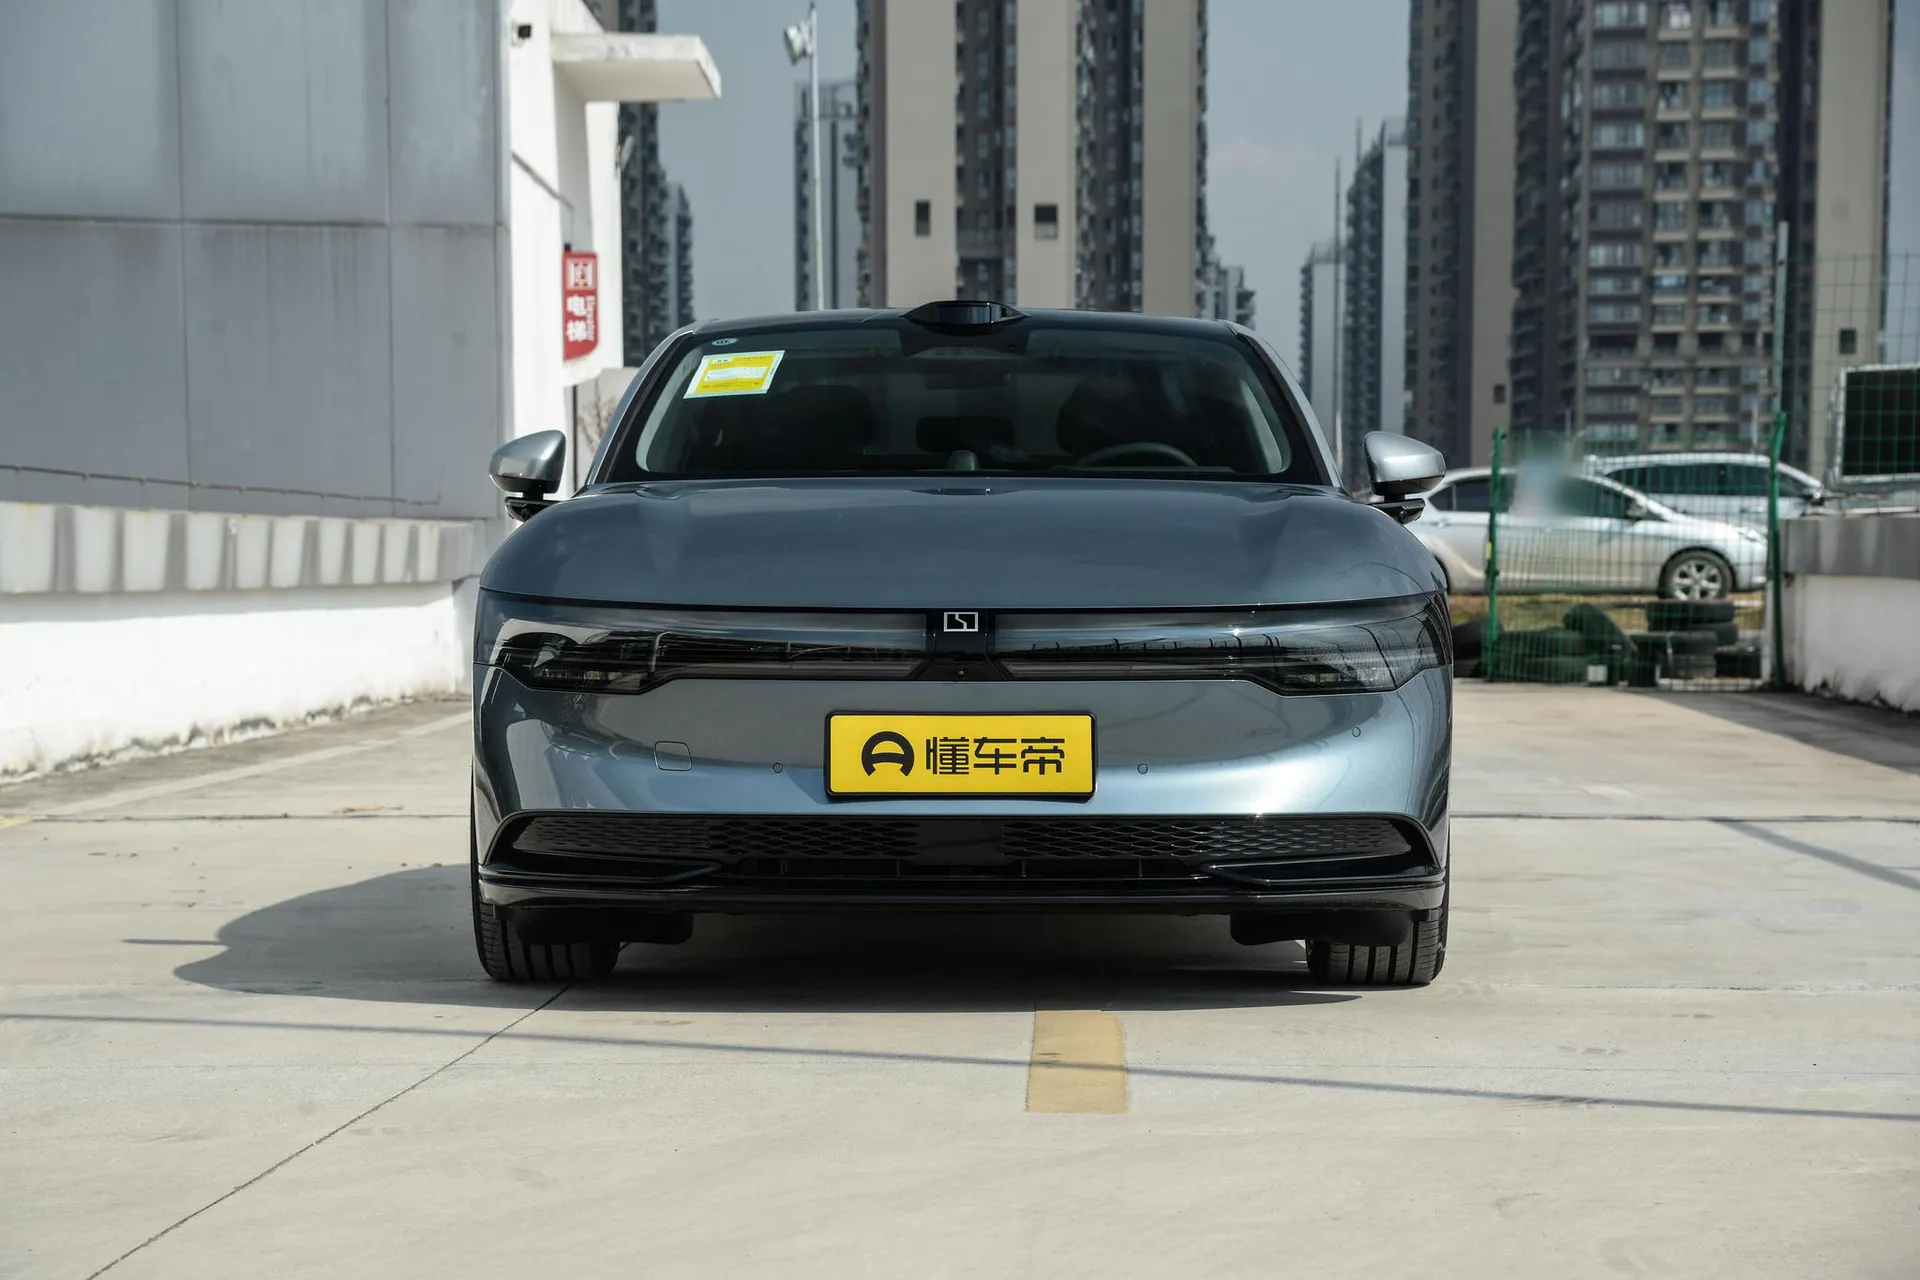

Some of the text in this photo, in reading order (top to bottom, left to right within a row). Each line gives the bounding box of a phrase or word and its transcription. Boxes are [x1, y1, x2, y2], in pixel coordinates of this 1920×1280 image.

[566, 295, 587, 342] 电梯
[925, 736, 1065, 775] 懂车帝
